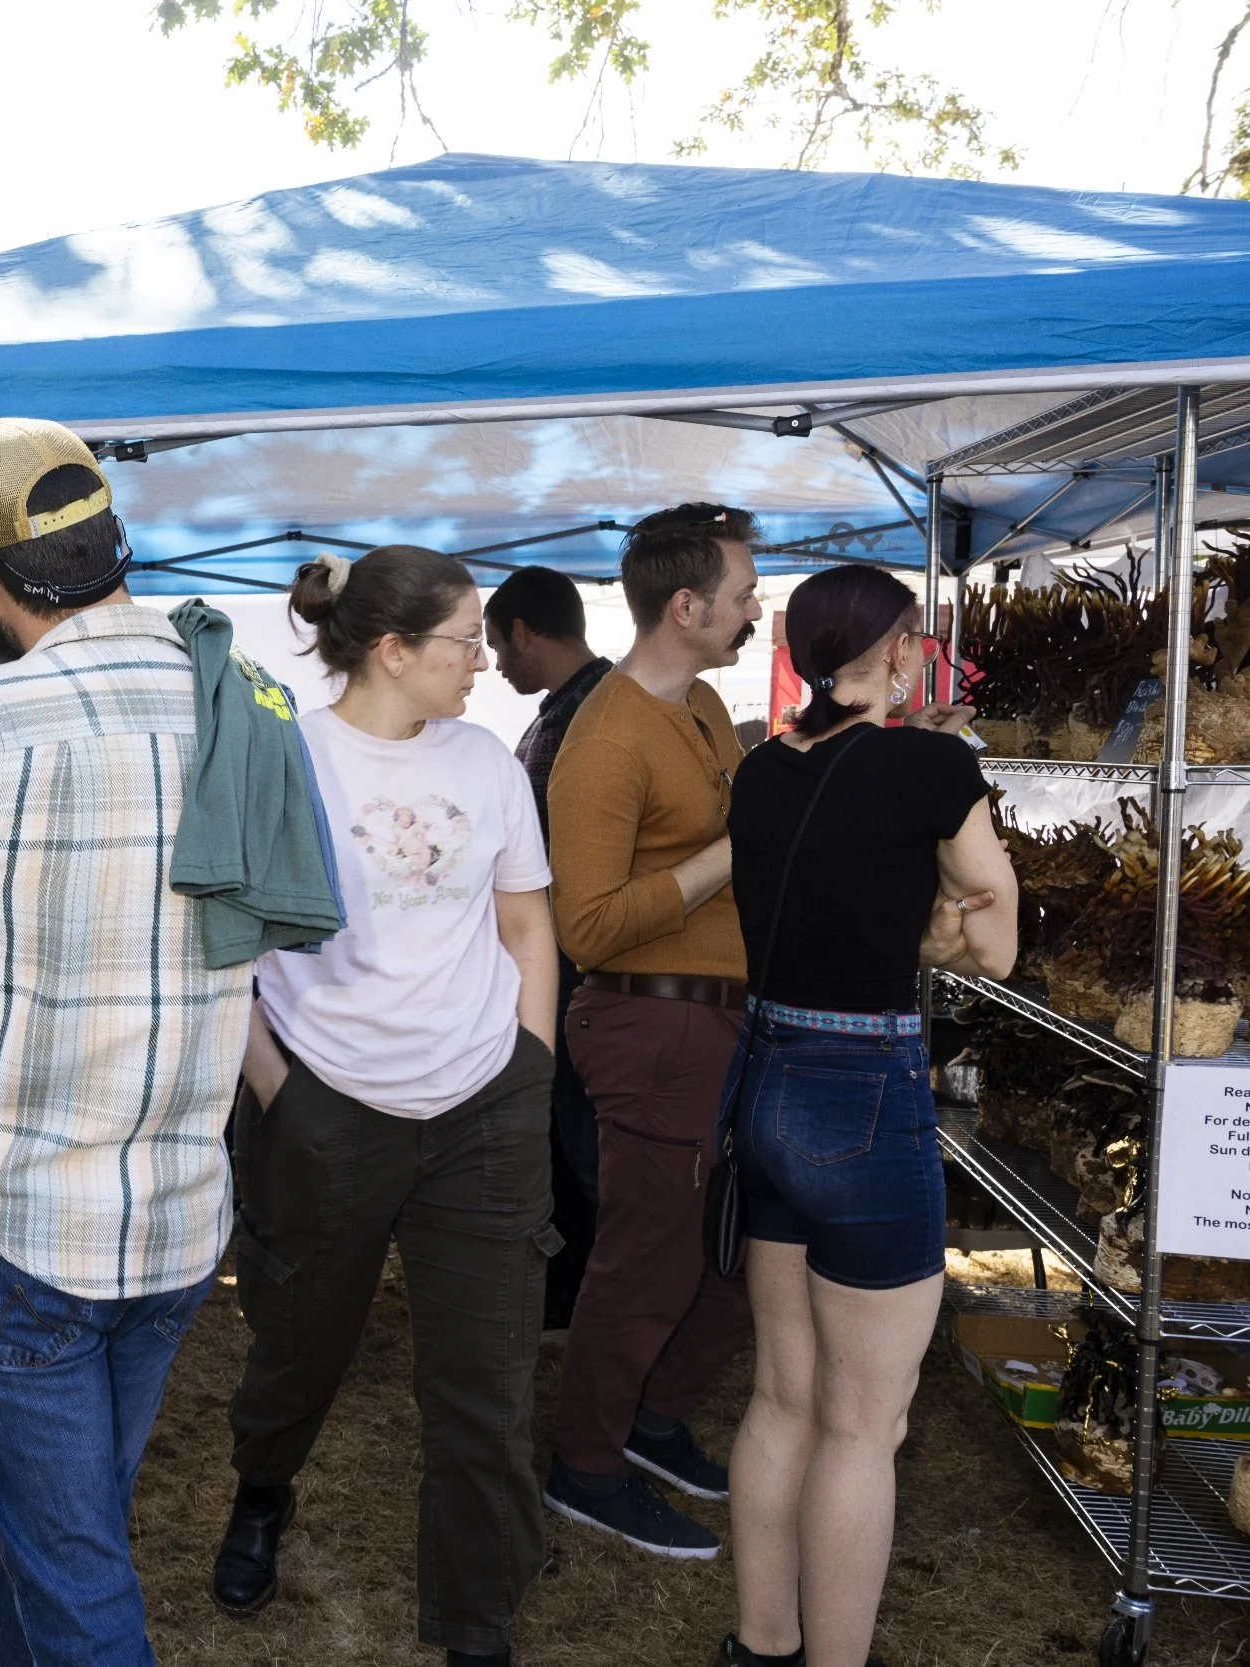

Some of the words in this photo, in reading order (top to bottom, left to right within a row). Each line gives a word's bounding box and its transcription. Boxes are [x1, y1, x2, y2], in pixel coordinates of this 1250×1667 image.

[1224, 1086, 1250, 1098] Rea
[1204, 1115, 1229, 1126] For
[1228, 1130, 1250, 1142] Ful
[1209, 1144, 1237, 1156] Sun
[1193, 1215, 1221, 1229] The
[1162, 1406, 1213, 1430] Baby
